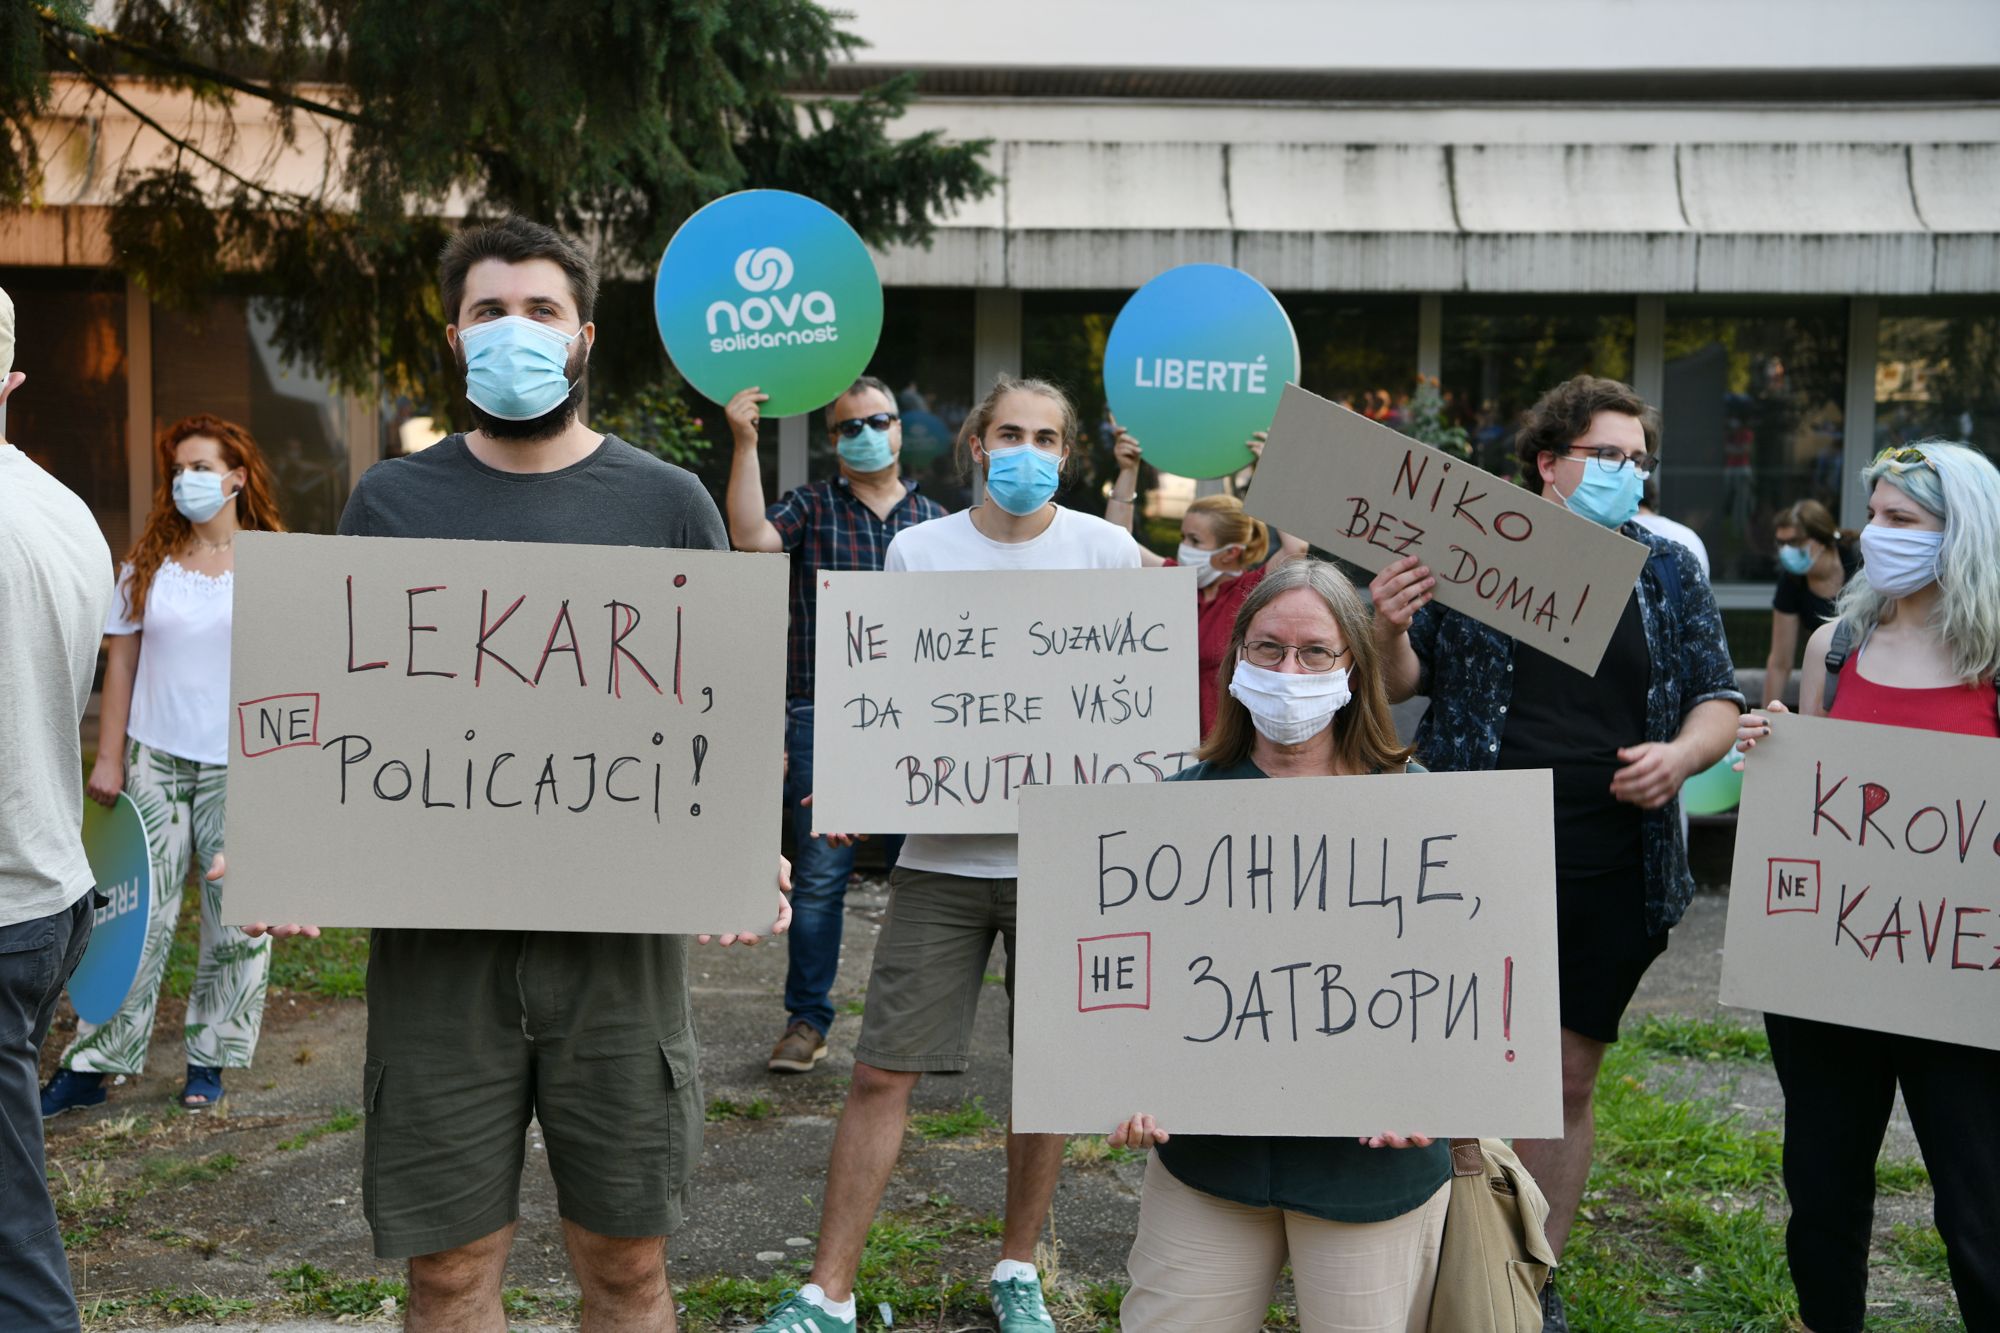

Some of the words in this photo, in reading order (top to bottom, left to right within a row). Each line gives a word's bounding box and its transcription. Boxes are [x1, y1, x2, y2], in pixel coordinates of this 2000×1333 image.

[705, 291, 836, 335] nova
[710, 325, 838, 353] solidarnost
[1135, 354, 1268, 394] LIBERTÉ
[1336, 497, 1426, 558] BEZ
[1440, 544, 1591, 644] DOMA!
[846, 611, 888, 668] NE
[914, 611, 998, 663] MOŽE
[1029, 611, 1169, 656] SUZAVAC
[259, 708, 311, 745] NE
[844, 693, 902, 730] DA
[931, 692, 1044, 728] SPERE
[1071, 674, 1153, 726] VAŠU
[1813, 760, 2000, 864] KROV
[92, 876, 139, 929] FREE
[1099, 830, 1481, 938] БОЛНИЦЕ,
[1777, 868, 1809, 900] NE
[1092, 956, 1136, 993] НЕ
[1184, 956, 1516, 1062] ЗАТВОРИ!
